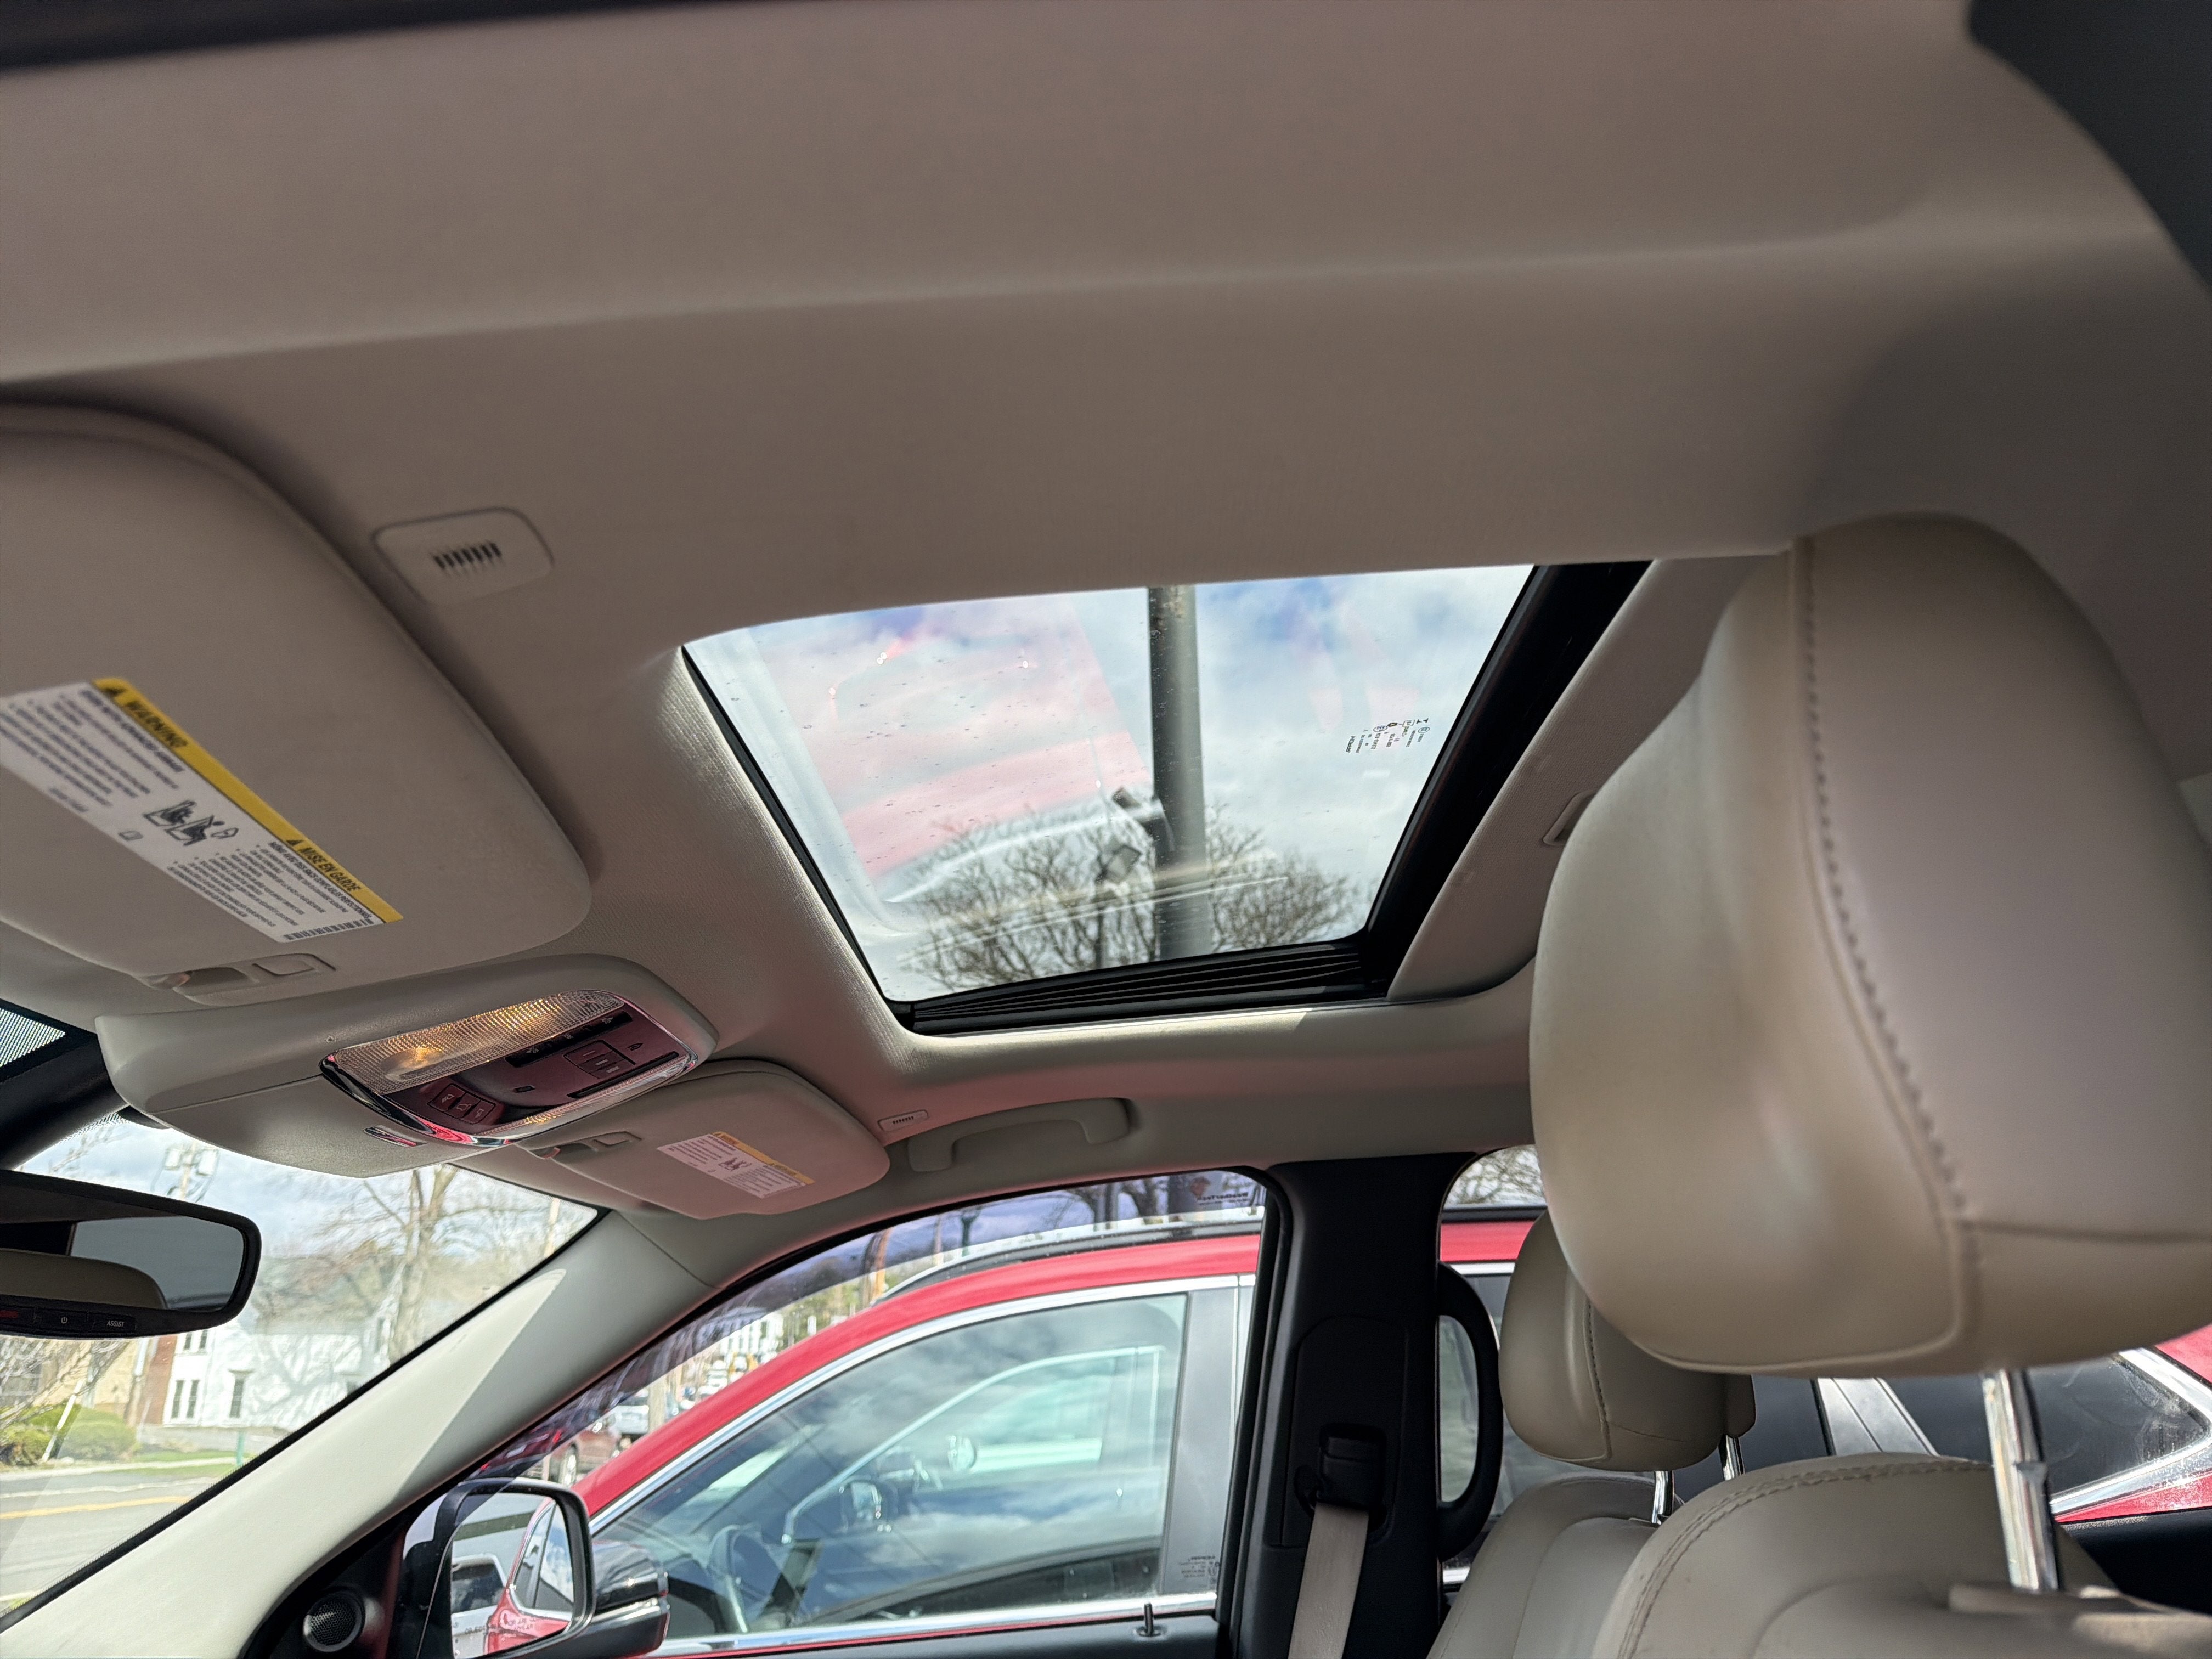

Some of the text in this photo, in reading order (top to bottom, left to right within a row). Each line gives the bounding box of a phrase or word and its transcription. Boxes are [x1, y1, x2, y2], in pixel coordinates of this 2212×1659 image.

[299, 847, 362, 891] MISE EN GARDE
